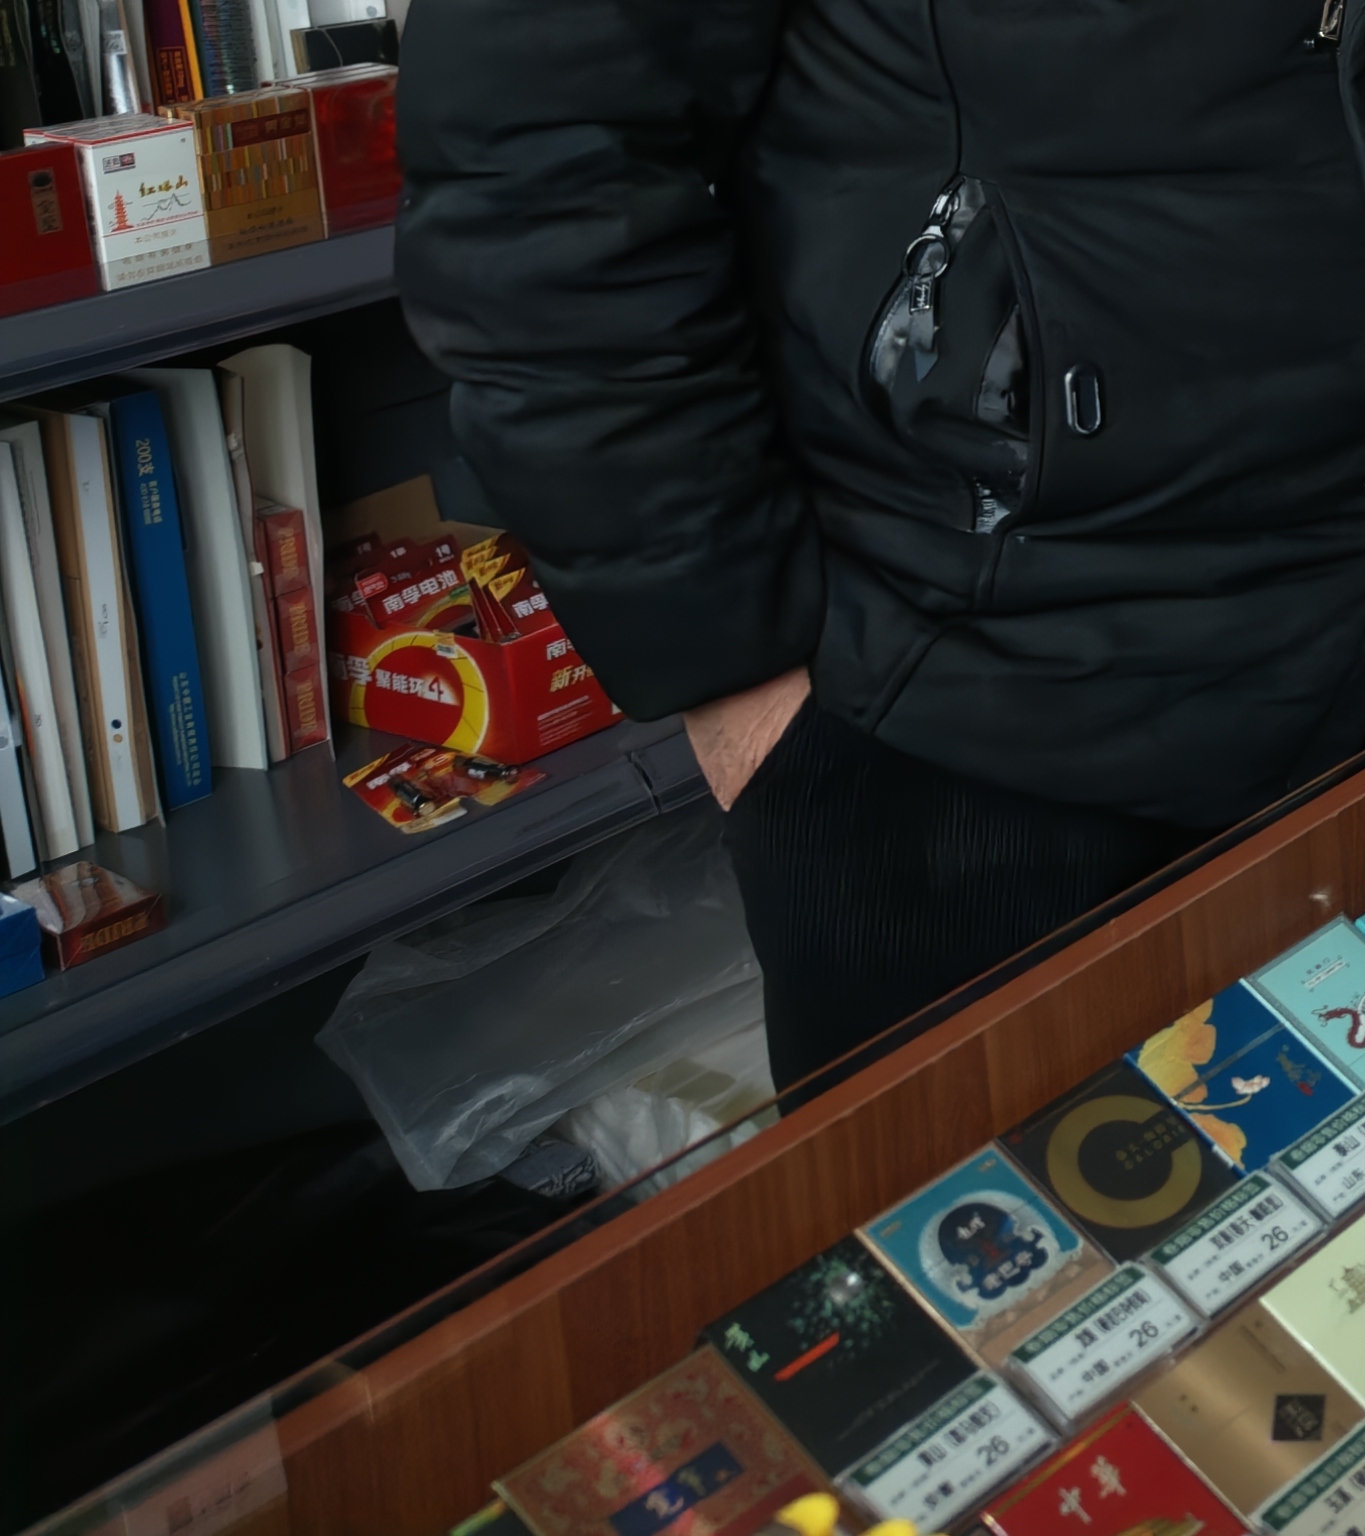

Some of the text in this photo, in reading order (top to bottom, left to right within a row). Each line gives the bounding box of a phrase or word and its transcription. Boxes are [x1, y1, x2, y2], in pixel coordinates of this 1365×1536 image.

[138, 175, 189, 198] 红塔山
[134, 438, 154, 477] 200支
[381, 569, 460, 615] 南孚电池
[1258, 1223, 1291, 1253] 26
[1125, 1316, 1162, 1351] 26
